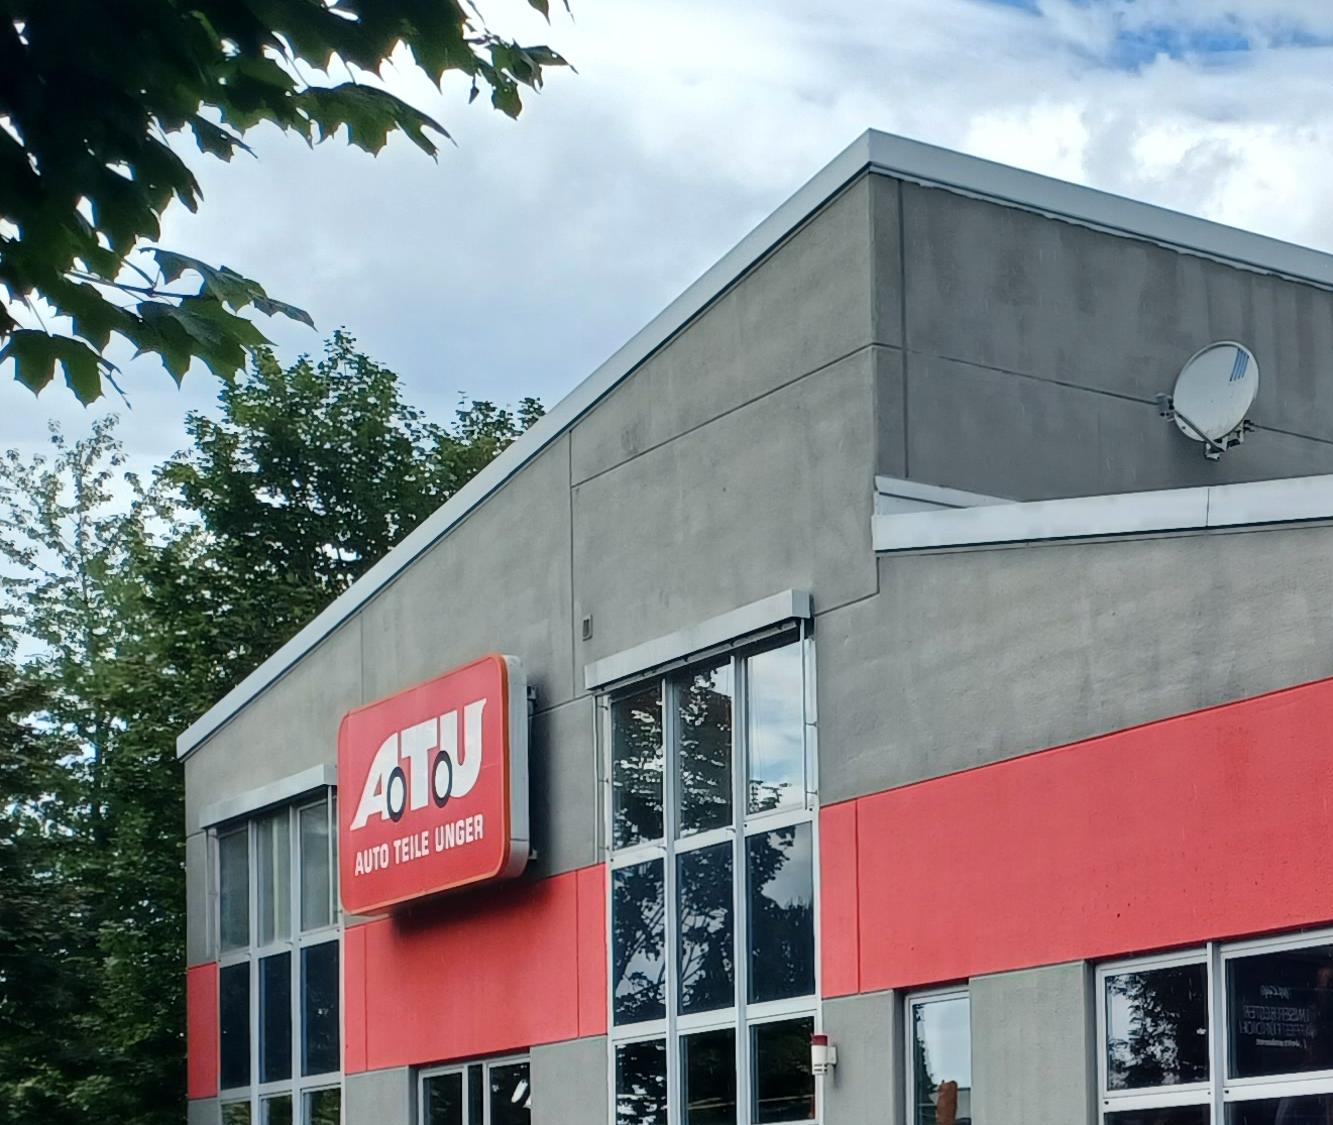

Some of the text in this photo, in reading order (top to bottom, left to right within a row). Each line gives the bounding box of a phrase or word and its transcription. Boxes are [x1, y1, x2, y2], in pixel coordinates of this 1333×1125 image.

[349, 698, 487, 831] ATU
[354, 813, 484, 877] AUTO TEILE UNGER
